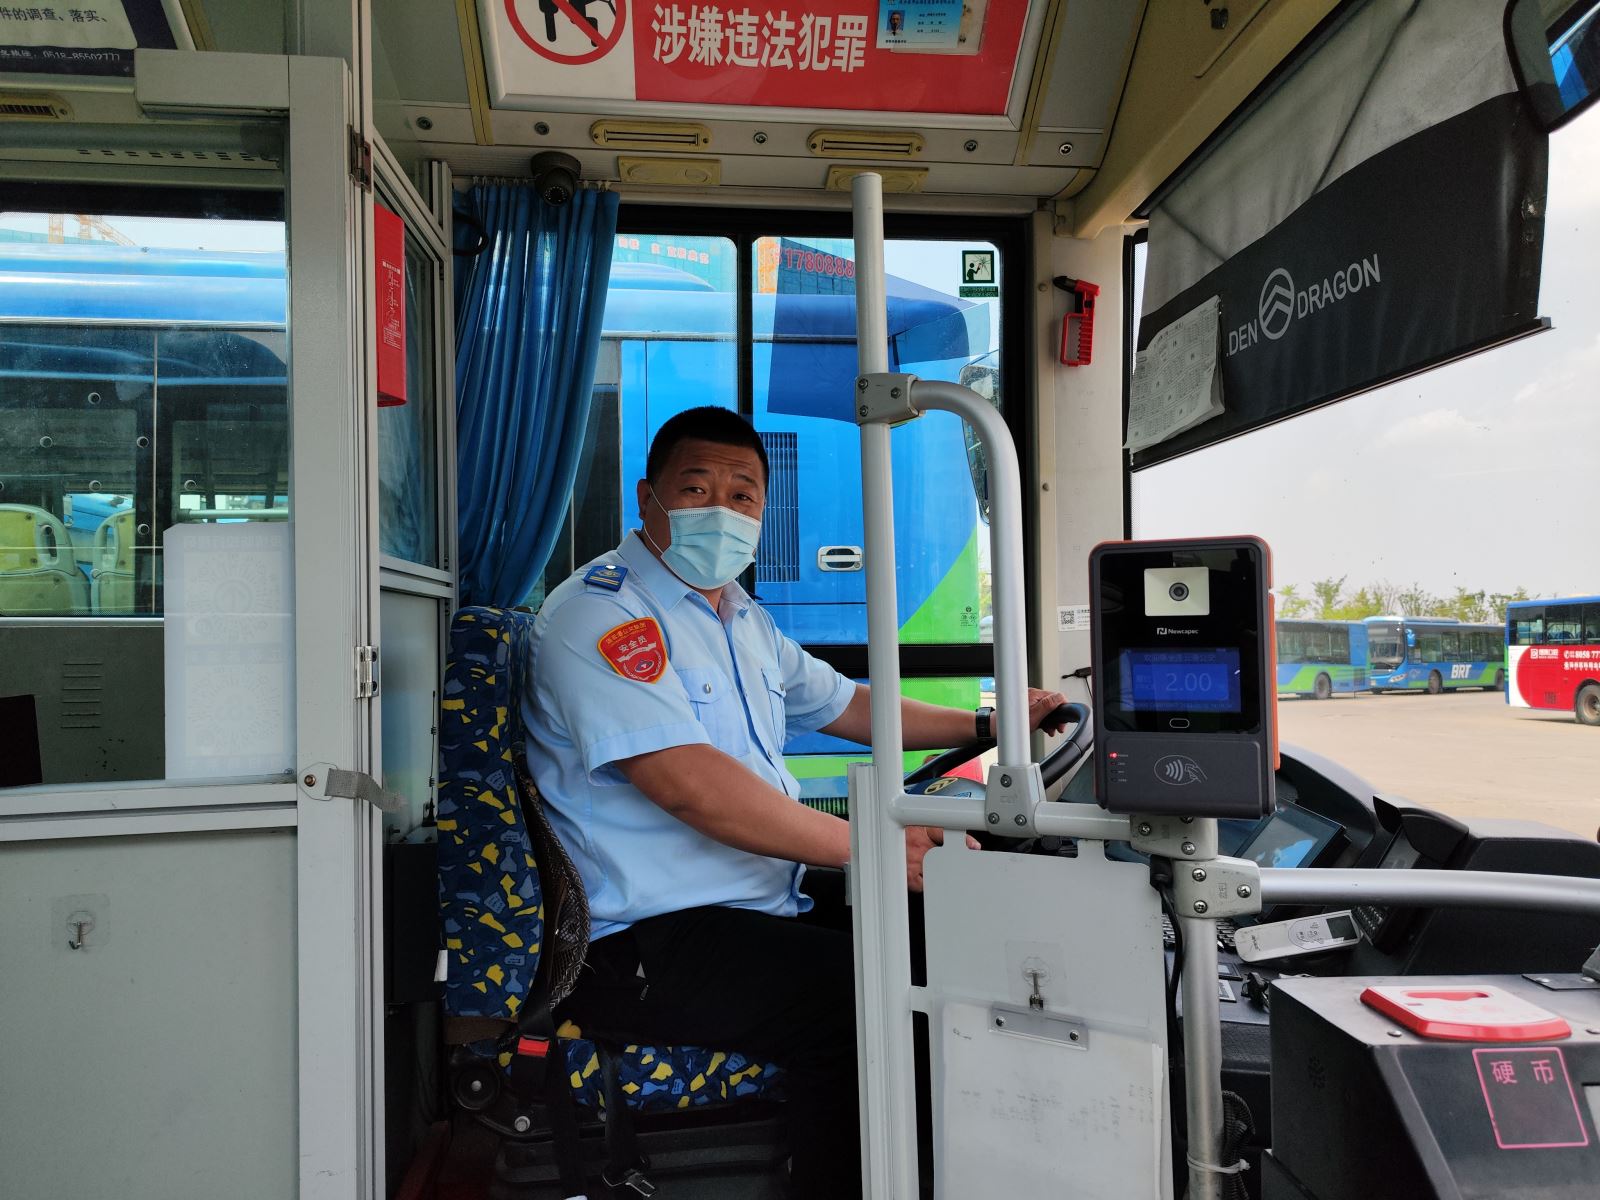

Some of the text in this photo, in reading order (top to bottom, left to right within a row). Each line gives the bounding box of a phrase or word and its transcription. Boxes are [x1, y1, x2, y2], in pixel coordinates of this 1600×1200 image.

[651, 3, 868, 72] 涉嫌违法犯罪
[1226, 254, 1381, 357] DEN DRAGON
[618, 635, 646, 652] 安全员
[1451, 664, 1472, 679] BRT
[1165, 672, 1212, 692] 2.00
